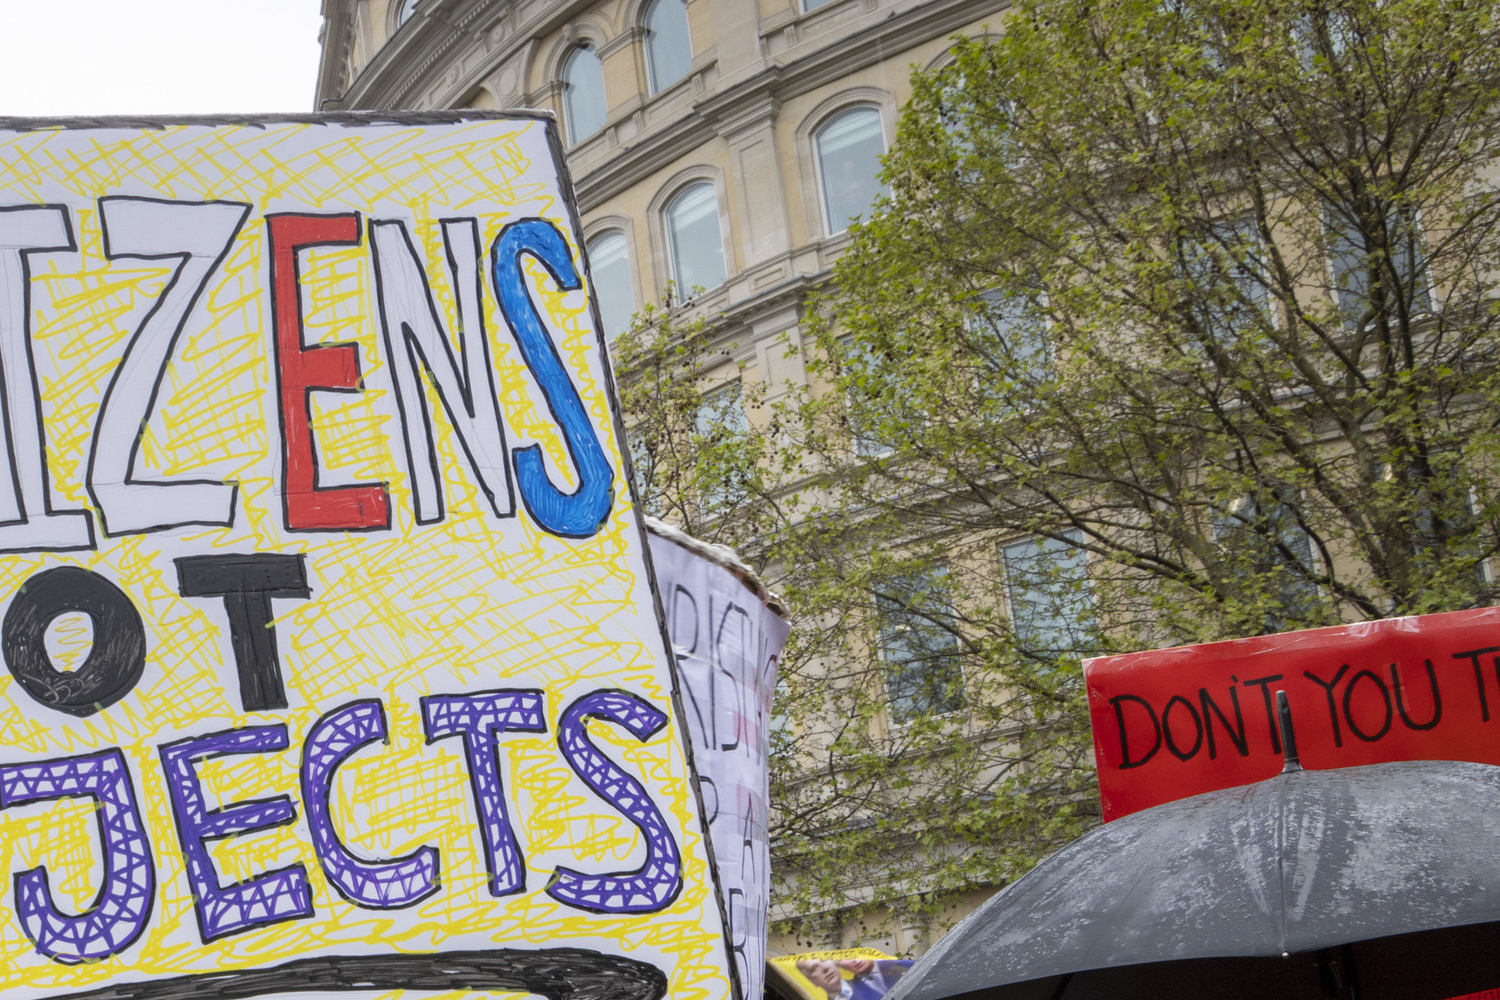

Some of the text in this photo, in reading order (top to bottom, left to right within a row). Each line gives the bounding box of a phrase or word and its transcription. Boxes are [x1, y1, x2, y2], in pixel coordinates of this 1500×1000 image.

[1109, 647, 1500, 770] DON'T YOU T
